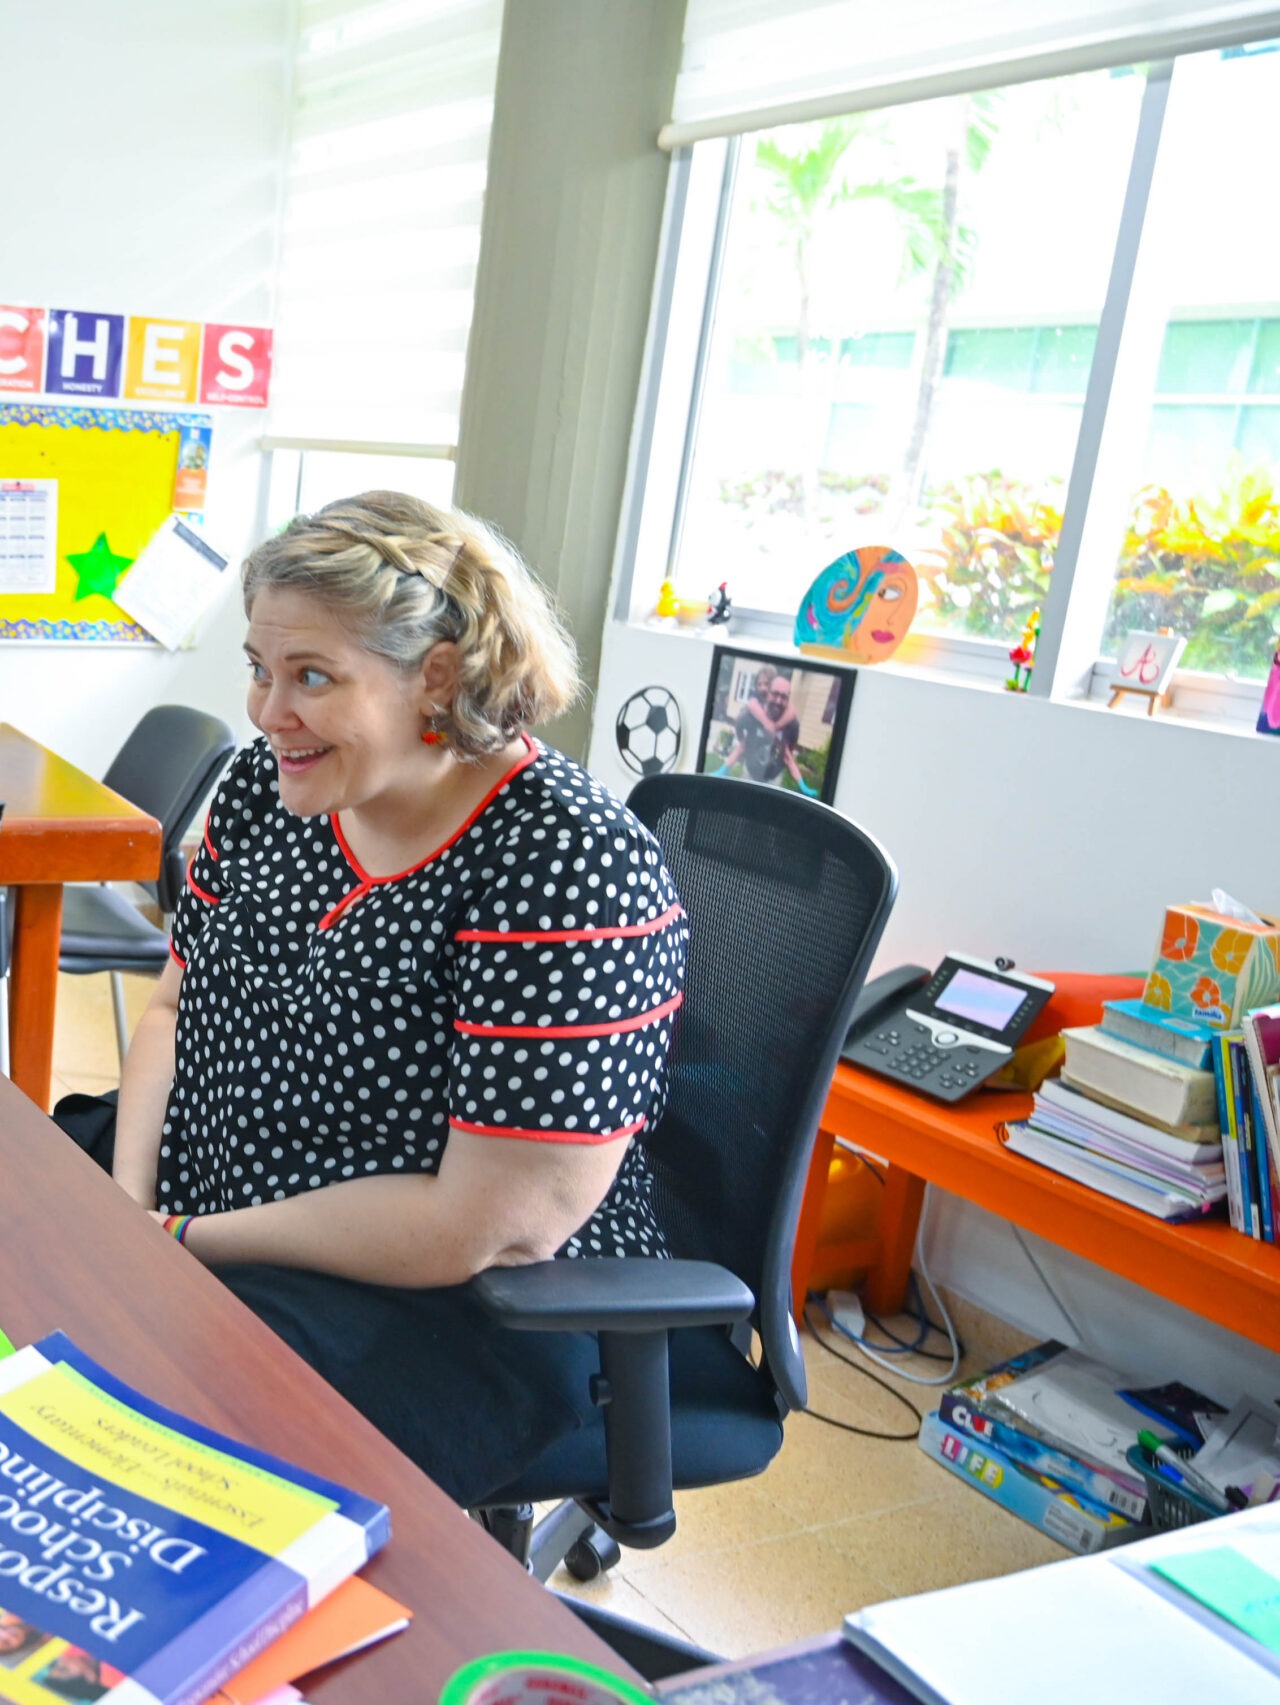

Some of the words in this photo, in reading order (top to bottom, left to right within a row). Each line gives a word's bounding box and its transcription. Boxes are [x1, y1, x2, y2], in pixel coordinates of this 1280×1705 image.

[62, 382, 102, 394] HONESTY
[951, 1405, 994, 1437] CLUE
[943, 1437, 1002, 1487] LIFE
